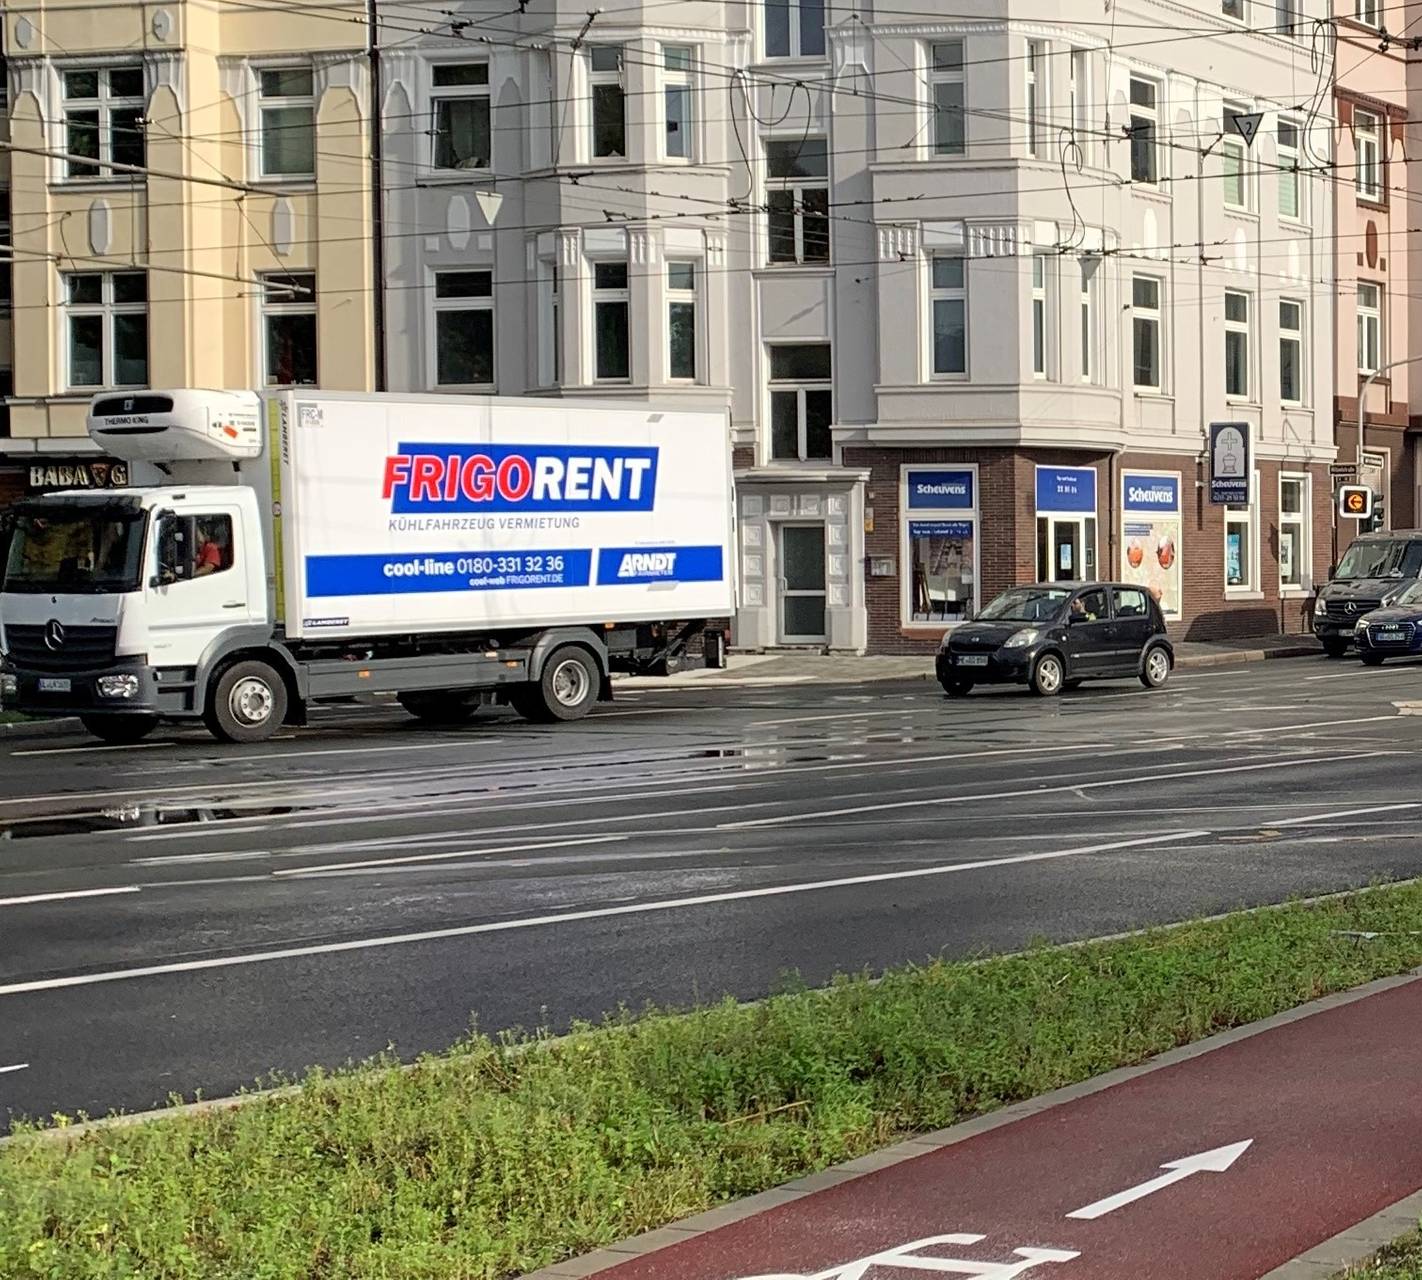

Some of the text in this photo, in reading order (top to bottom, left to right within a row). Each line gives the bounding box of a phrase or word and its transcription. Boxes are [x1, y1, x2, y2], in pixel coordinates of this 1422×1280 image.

[104, 416, 149, 425] THERMO KING
[30, 466, 89, 486] BABA
[382, 454, 651, 502] FRIGORENT
[917, 484, 966, 494] Scheuvens
[1212, 480, 1247, 488] Scheuvens
[1128, 487, 1173, 503] Scheuvens
[389, 517, 580, 531] KÜHLFAHRZEUG VERMIETUNG
[457, 557, 521, 574] 0180-331
[525, 556, 542, 571] 32
[545, 556, 564, 571] 36
[617, 553, 676, 577] ARNDT
[506, 574, 564, 584] FRIGORENT.DE
